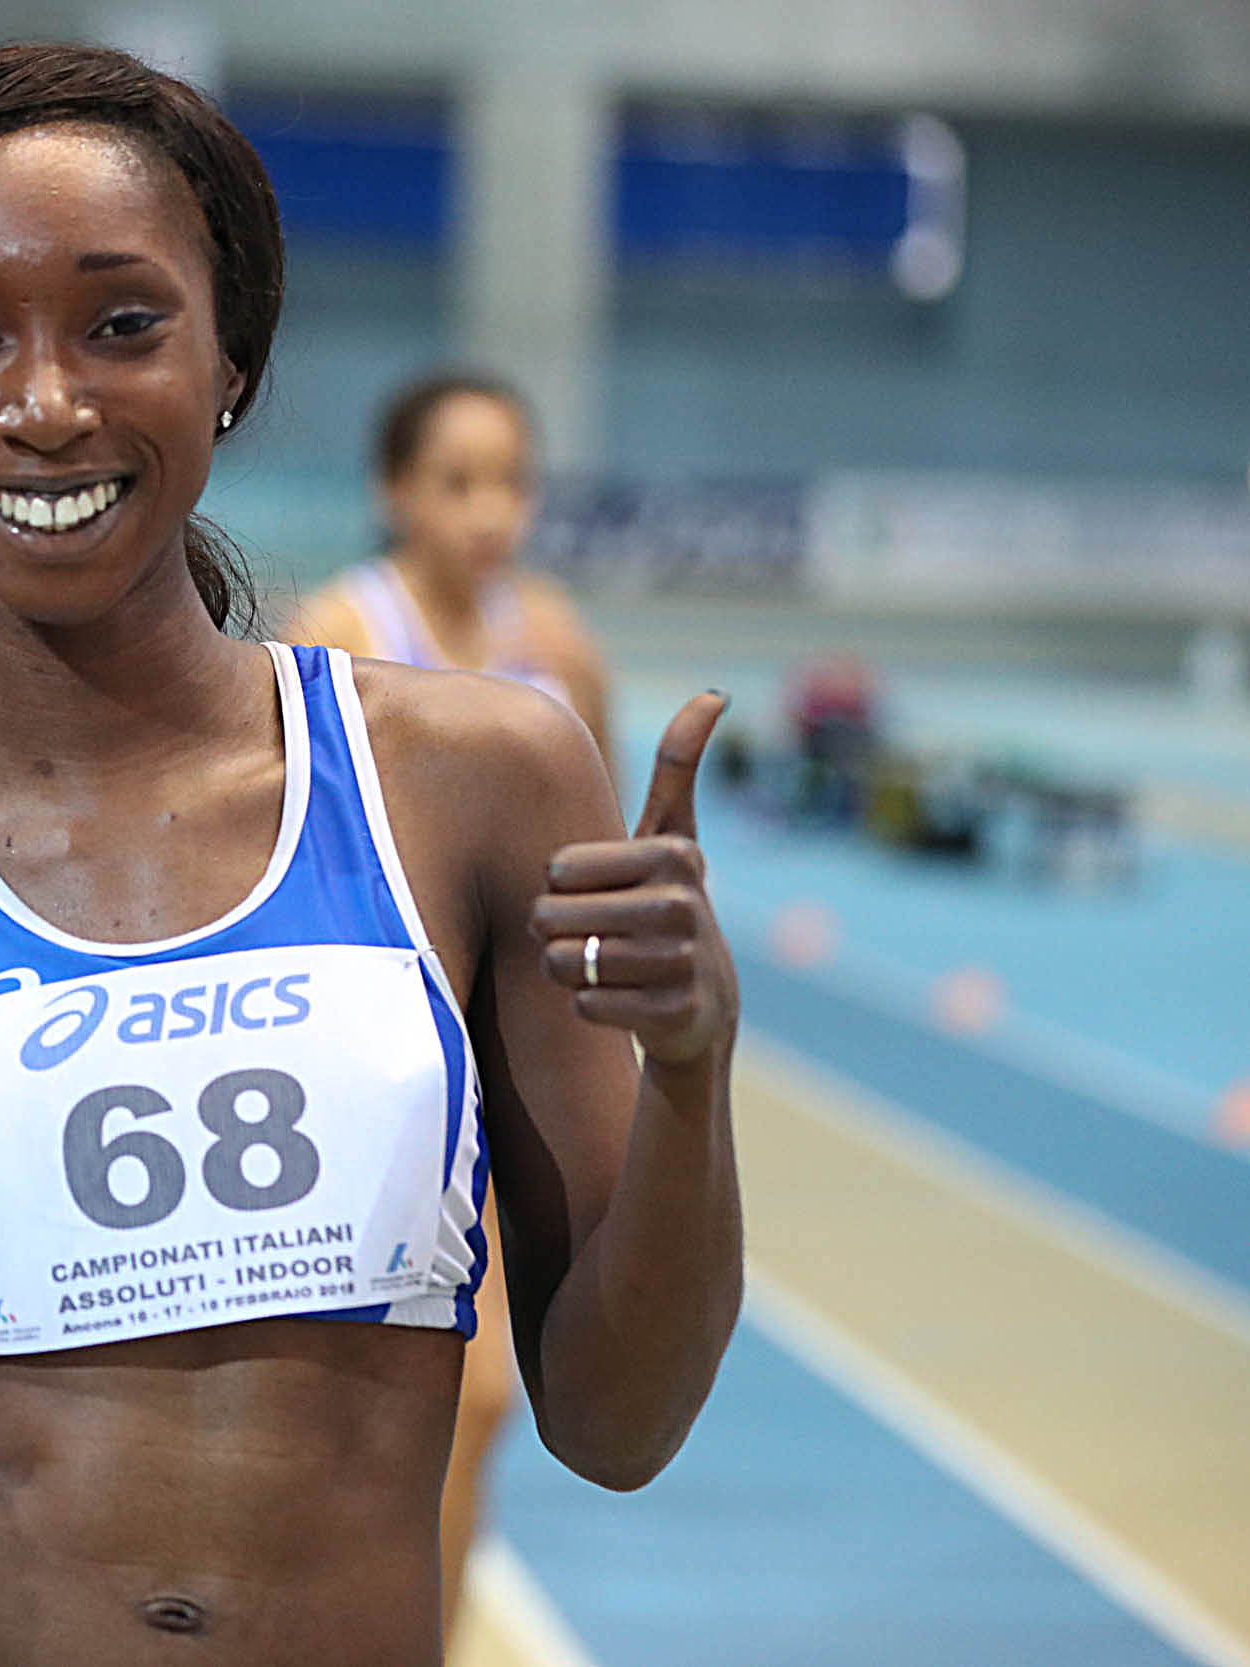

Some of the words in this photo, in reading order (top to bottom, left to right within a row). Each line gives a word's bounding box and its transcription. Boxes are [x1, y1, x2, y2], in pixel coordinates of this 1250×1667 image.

[63, 1068, 320, 1229] 68
[51, 1240, 223, 1282] CAMPIONATI
[234, 1222, 353, 1255] ITALIANI
[58, 1273, 206, 1313] ASSOLUTI
[235, 1255, 354, 1286] INDOOR
[62, 1317, 122, 1335] Ancona
[164, 1304, 181, 1318] 17
[225, 1286, 312, 1308] FEBBRAIO
